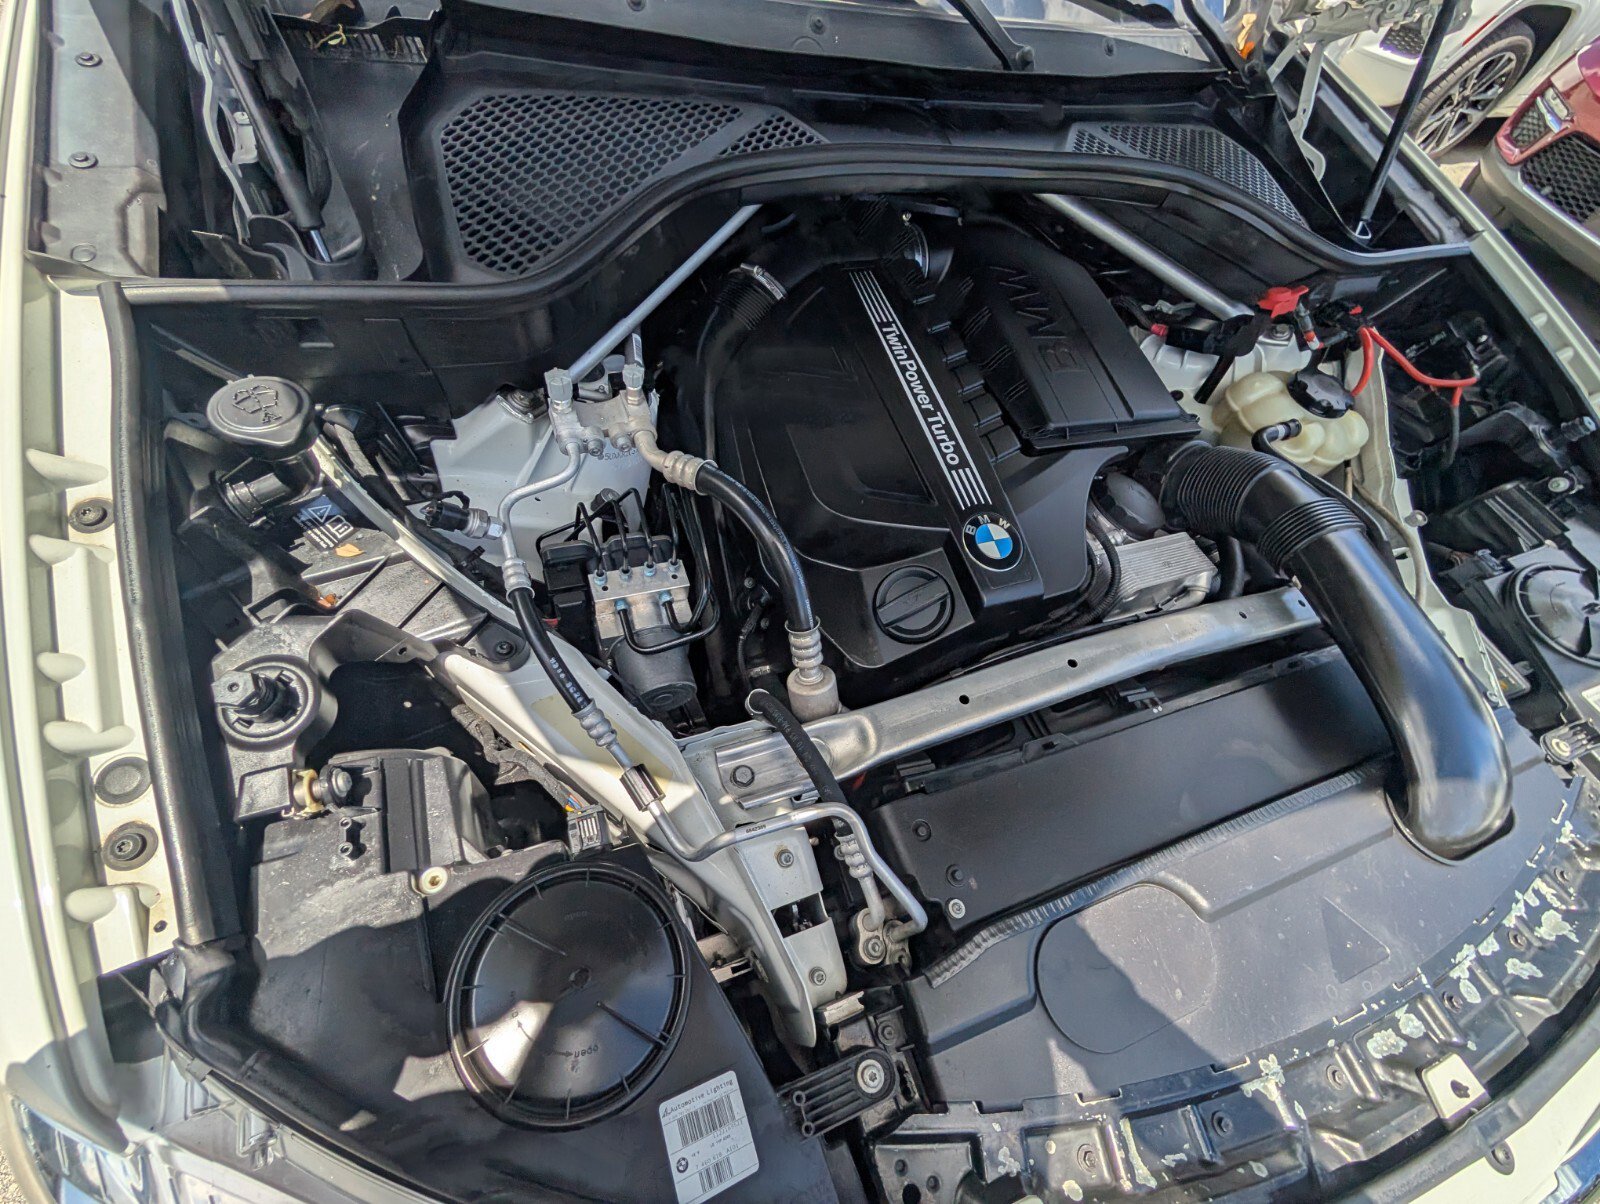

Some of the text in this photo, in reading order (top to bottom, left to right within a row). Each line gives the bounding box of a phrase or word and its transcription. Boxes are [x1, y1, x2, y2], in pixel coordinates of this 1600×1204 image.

[882, 323, 960, 466] TwinPower Turbo
[965, 514, 1011, 536] BMW
[574, 1044, 599, 1058] open
[670, 1094, 705, 1112] Automotive
[706, 1079, 734, 1096] Lighting
